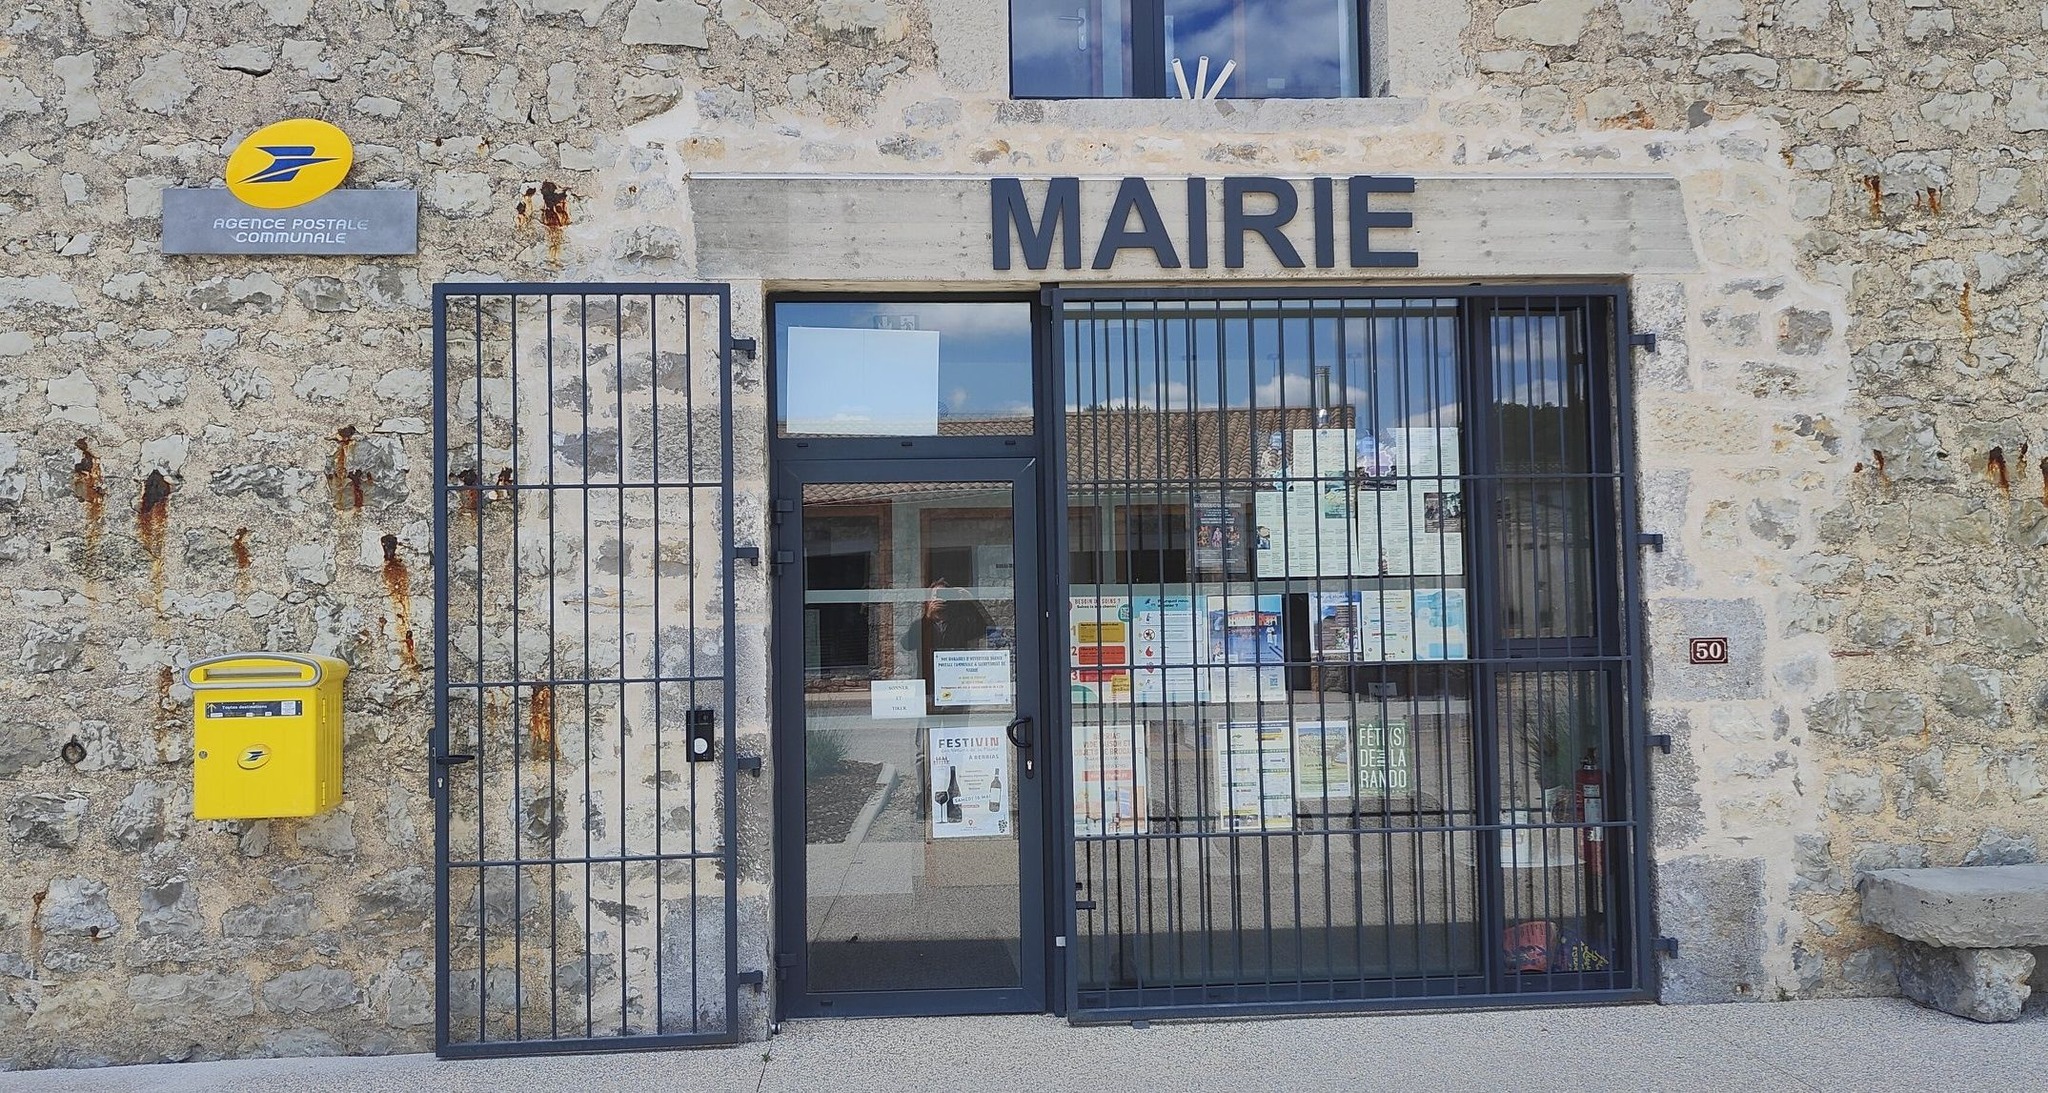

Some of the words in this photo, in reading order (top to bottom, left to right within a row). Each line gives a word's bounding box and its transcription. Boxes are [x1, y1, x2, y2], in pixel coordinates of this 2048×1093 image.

[212, 218, 286, 230] AGENCE
[292, 218, 369, 230] POSTALE
[990, 175, 1419, 270] MAIRIE
[235, 231, 346, 244] COMMUNALE
[1071, 646, 1077, 656] 2
[1696, 642, 1722, 659] 50
[938, 737, 999, 748] FESTIVIN
[1359, 723, 1406, 747] FÊT(S)
[1360, 749, 1376, 767] DE
[1390, 749, 1407, 767] LA
[1360, 769, 1407, 788] RANDO
